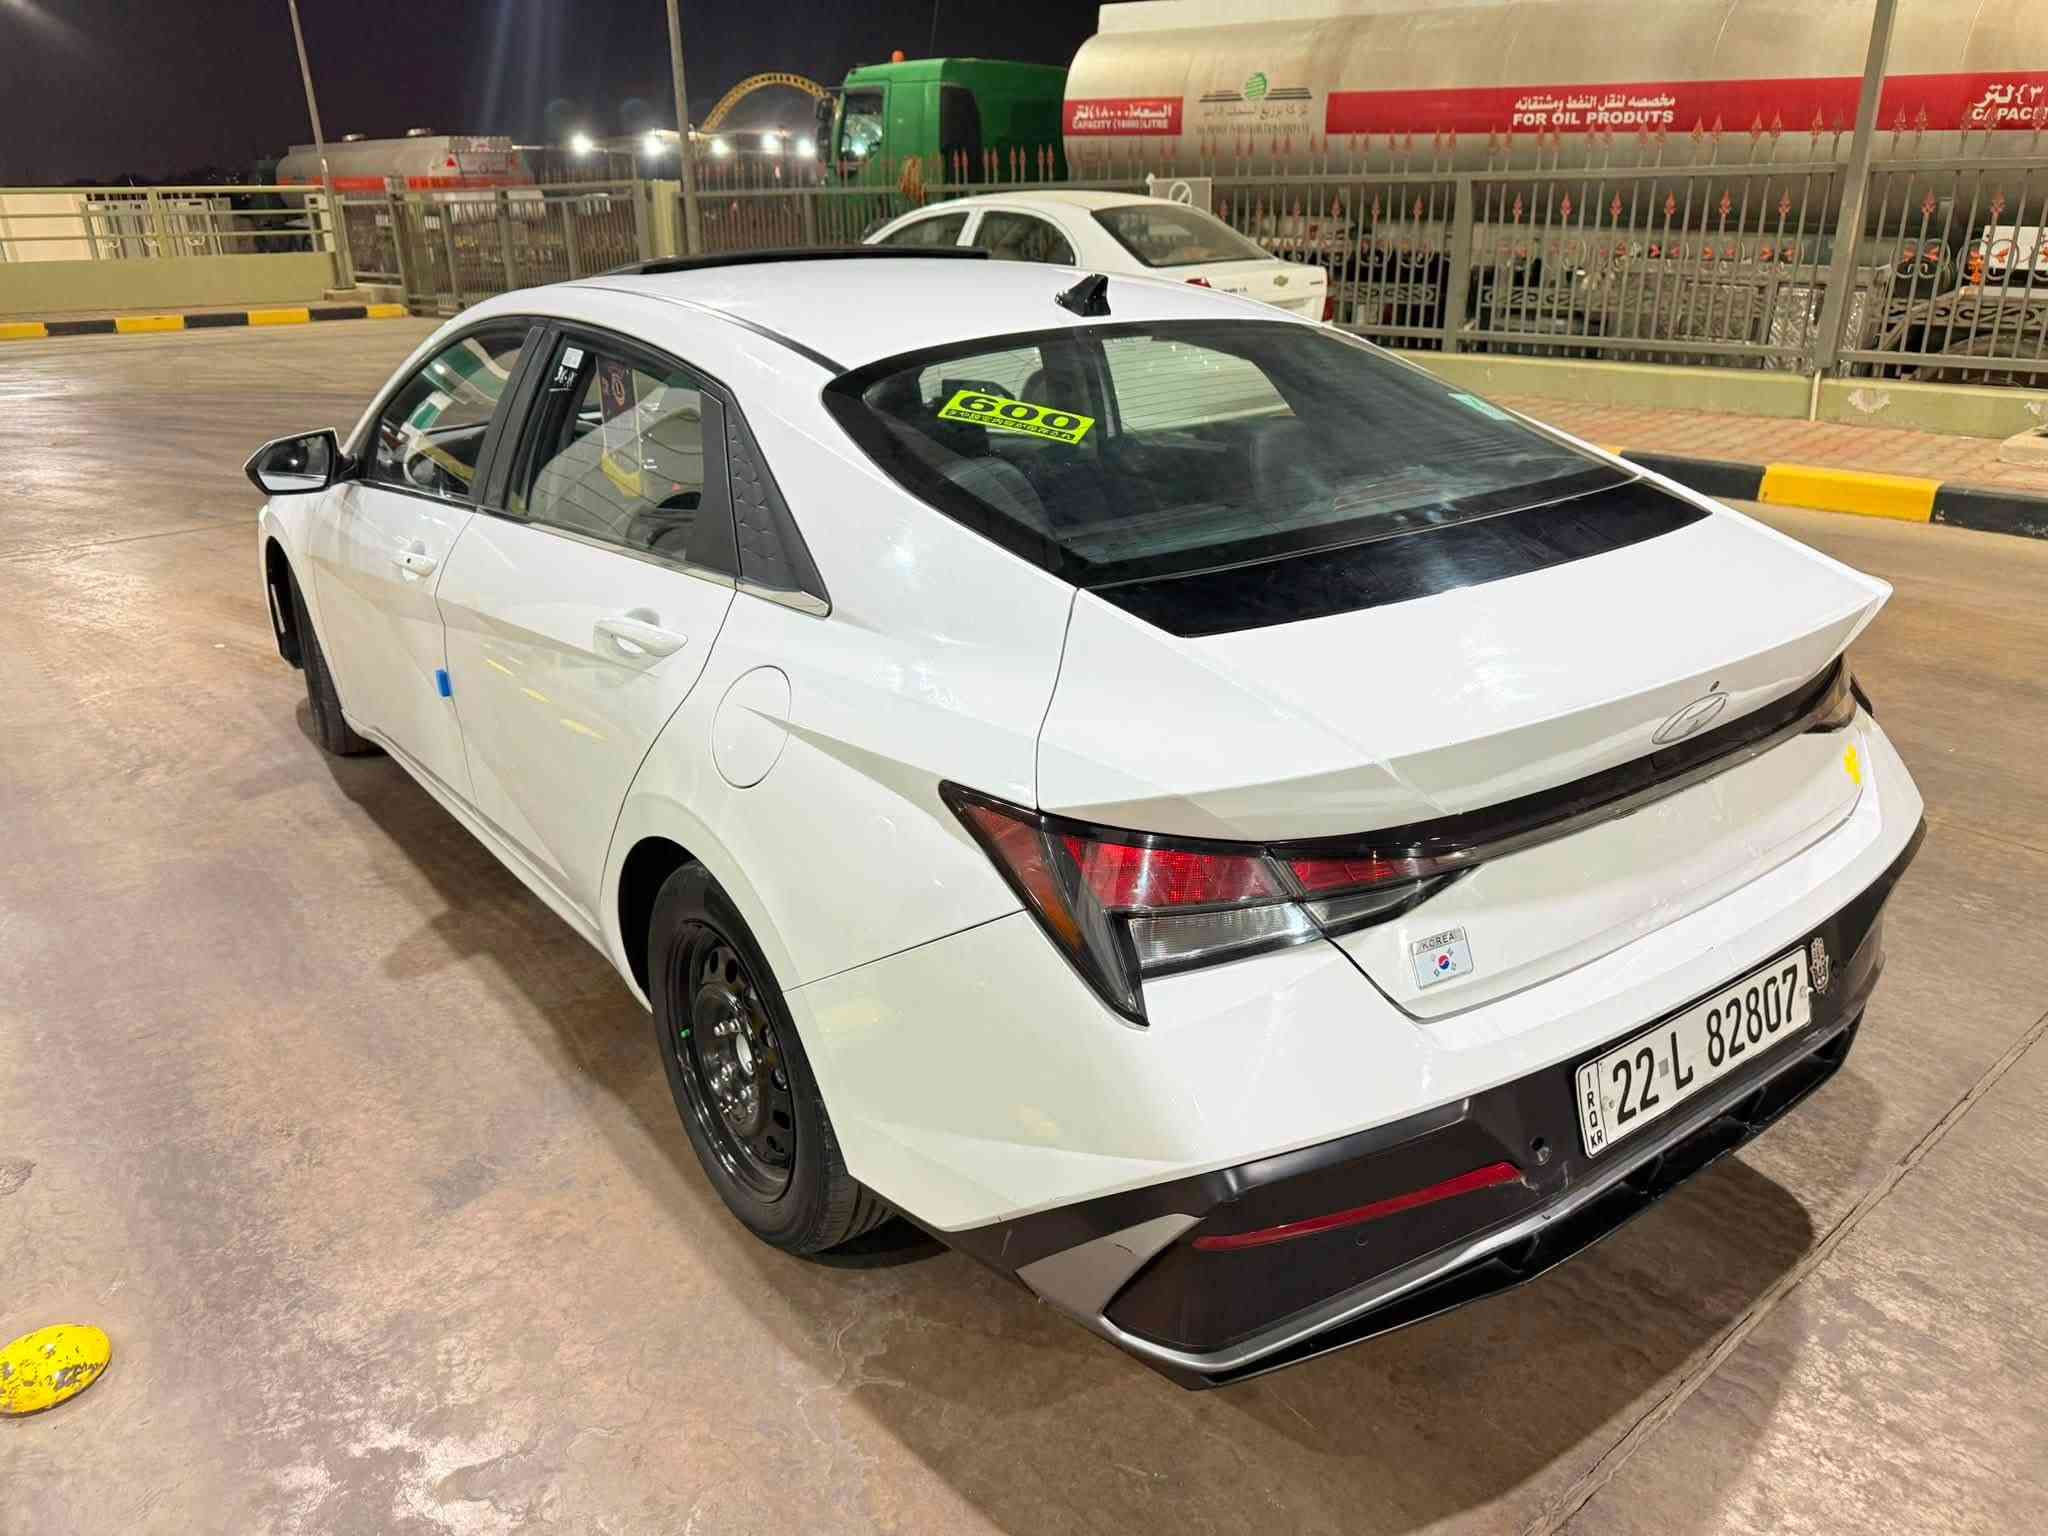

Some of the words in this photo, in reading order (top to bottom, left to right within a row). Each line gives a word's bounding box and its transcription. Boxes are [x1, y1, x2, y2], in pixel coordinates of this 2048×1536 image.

[1566, 94, 1597, 109] النفط
[1597, 93, 1626, 110] لنقل
[1512, 112, 1547, 126] FOR
[1551, 111, 1581, 125] OIL
[1585, 110, 1674, 125] PRODUTS
[959, 395, 1081, 431] 600
[1612, 1046, 1660, 1126] 22
[1670, 1031, 1694, 1090] L
[1705, 963, 1798, 1068] 82807
[1590, 1129, 1604, 1148] KR
